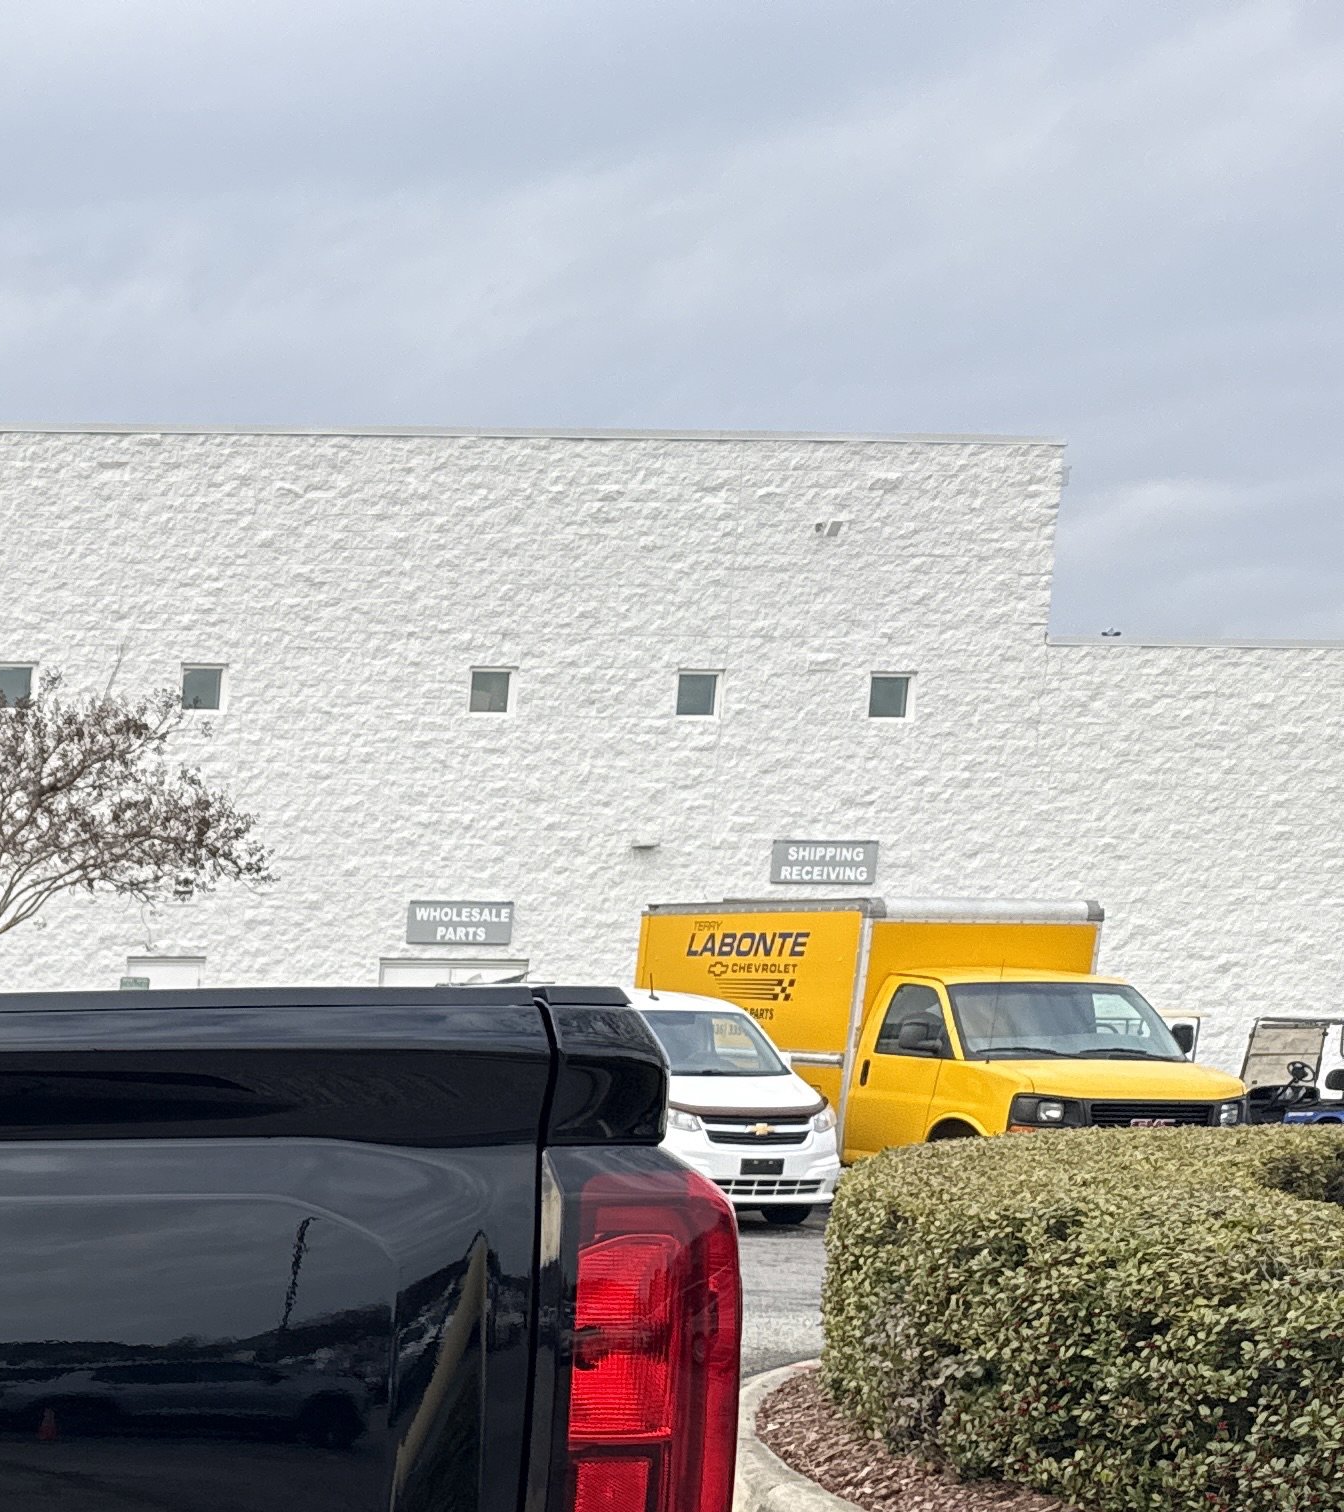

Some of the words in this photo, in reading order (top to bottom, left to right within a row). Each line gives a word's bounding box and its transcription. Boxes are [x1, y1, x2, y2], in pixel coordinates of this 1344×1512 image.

[787, 846, 865, 861] SHIPPING
[780, 865, 868, 881] RECEIVING
[415, 907, 511, 922] WHOLESALE
[693, 920, 723, 931] TERRY
[436, 926, 486, 941] PARTS
[686, 932, 811, 957] LABONTE
[731, 963, 798, 974] CHEVROLET
